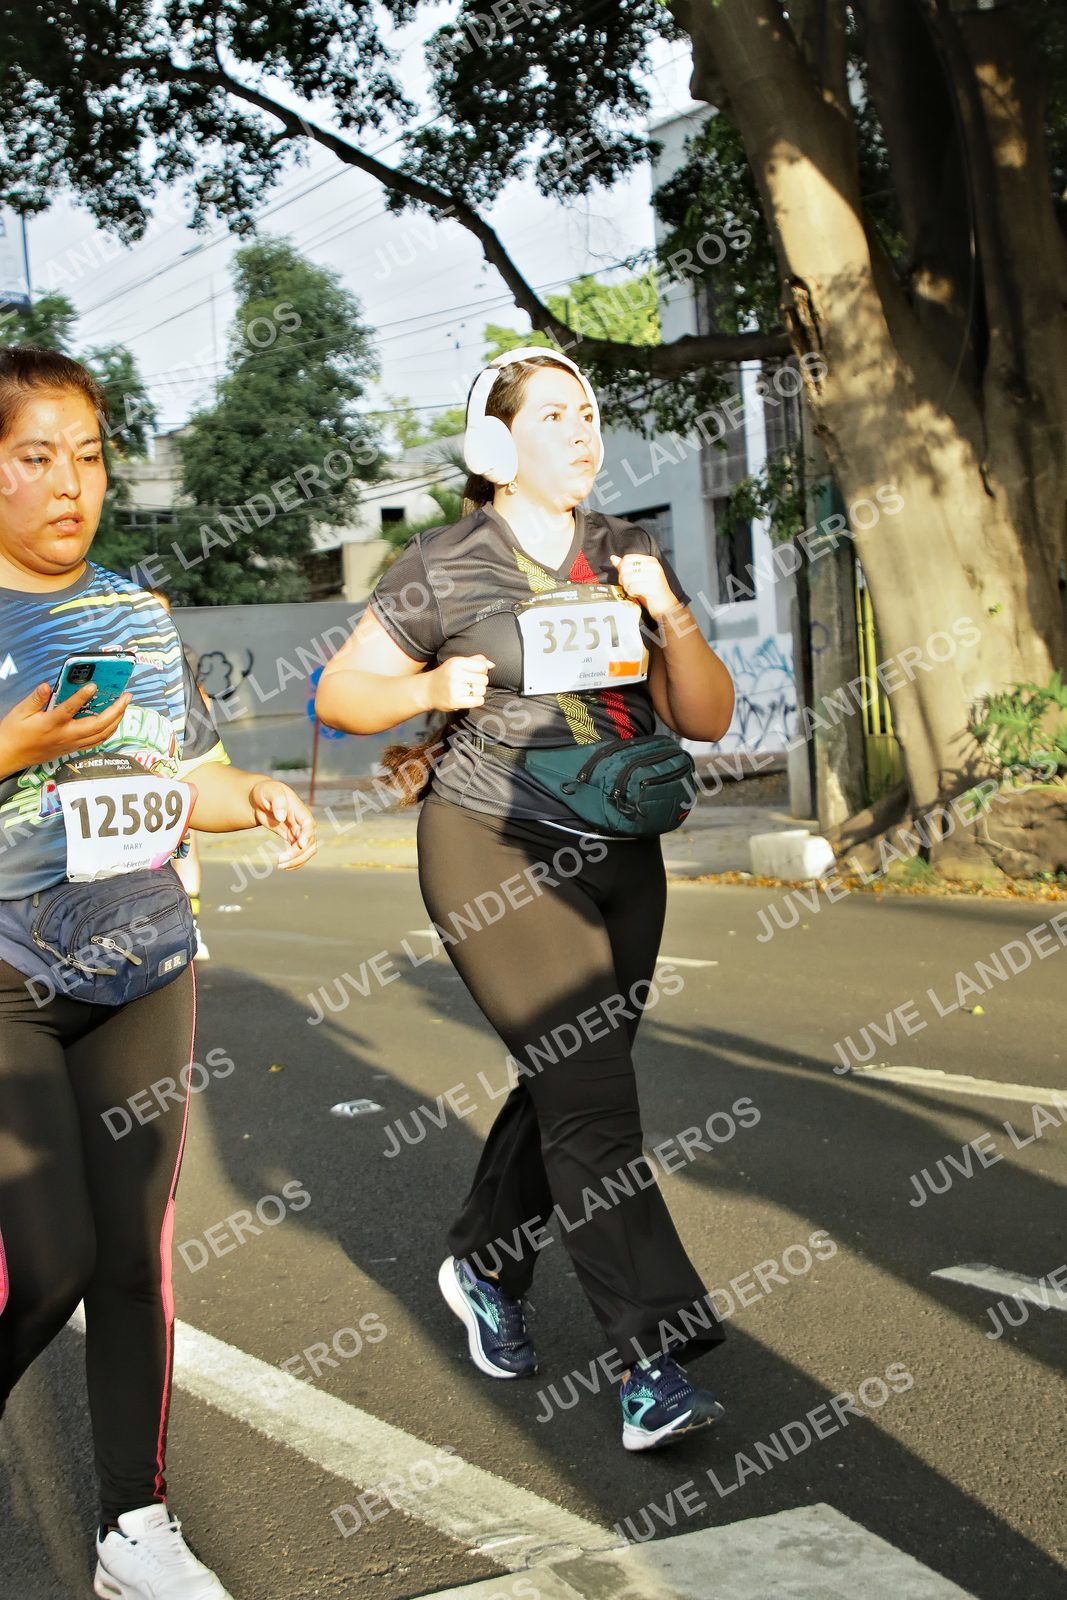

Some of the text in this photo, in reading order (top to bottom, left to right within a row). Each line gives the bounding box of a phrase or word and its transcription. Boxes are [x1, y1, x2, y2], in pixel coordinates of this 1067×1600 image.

[538, 614, 620, 654] 3251
[70, 789, 183, 840] 12589
[123, 842, 143, 851] MARY
